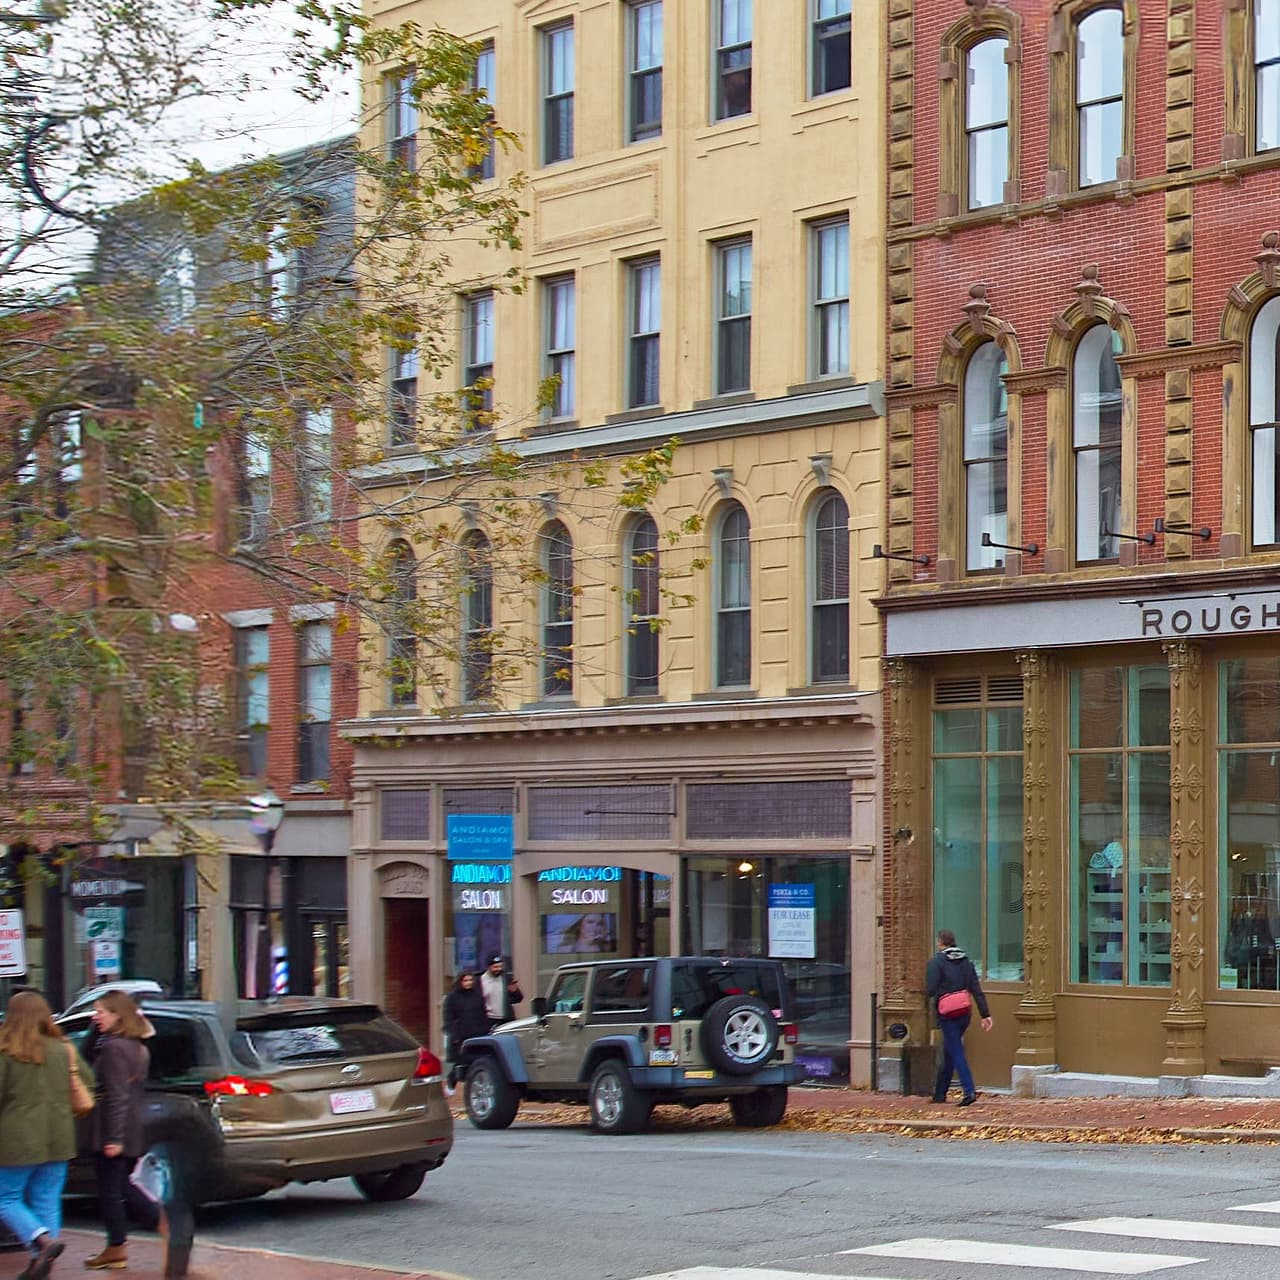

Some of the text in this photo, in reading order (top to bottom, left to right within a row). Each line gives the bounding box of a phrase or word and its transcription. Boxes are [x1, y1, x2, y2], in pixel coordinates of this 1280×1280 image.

[1141, 603, 1280, 636] ROUGH
[452, 864, 512, 884] ANDIAMO!
[538, 866, 622, 882] ANDIAMO!
[461, 890, 501, 909] SALON
[551, 889, 606, 904] SALON
[773, 911, 810, 920] FOR LEASE
